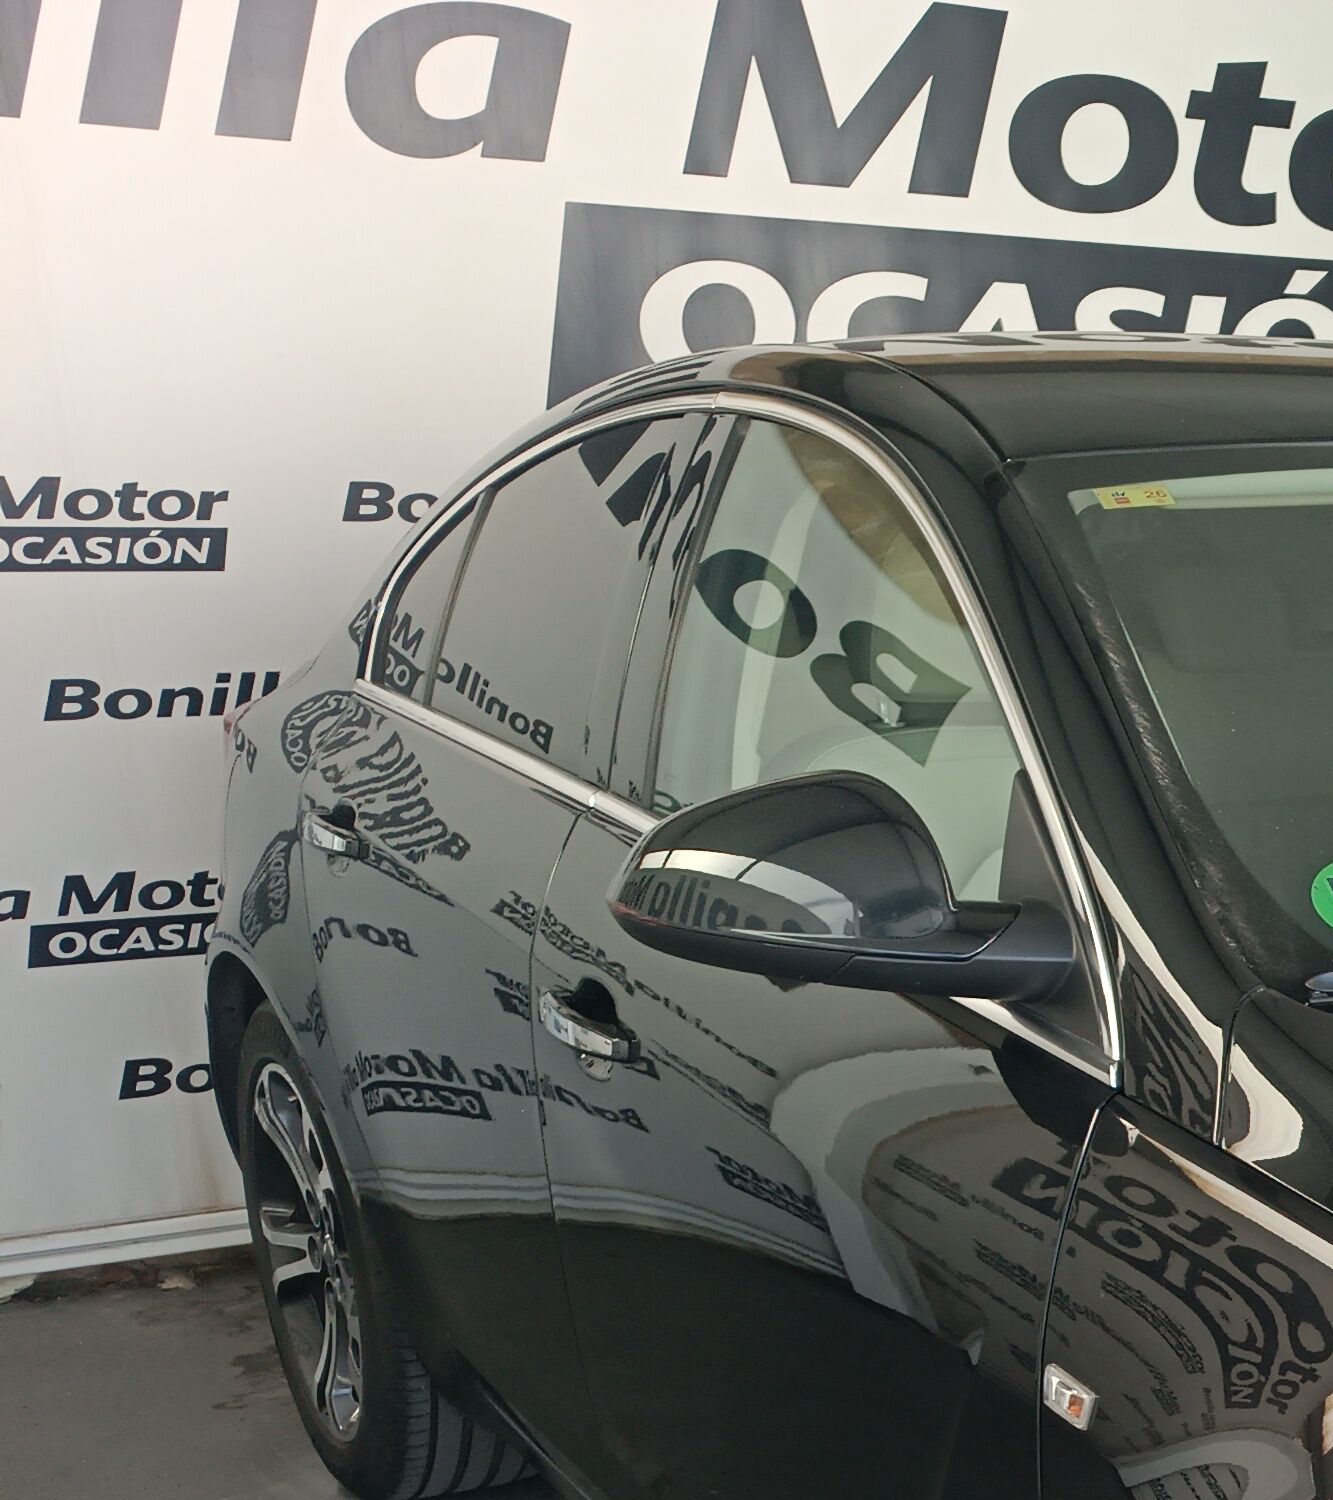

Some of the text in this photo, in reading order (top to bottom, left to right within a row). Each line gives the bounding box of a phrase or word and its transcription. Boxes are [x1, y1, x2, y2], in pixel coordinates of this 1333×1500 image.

[0, 530, 210, 564] CASIÓN
[58, 870, 224, 917] Mot
[48, 924, 216, 960] OCASI
